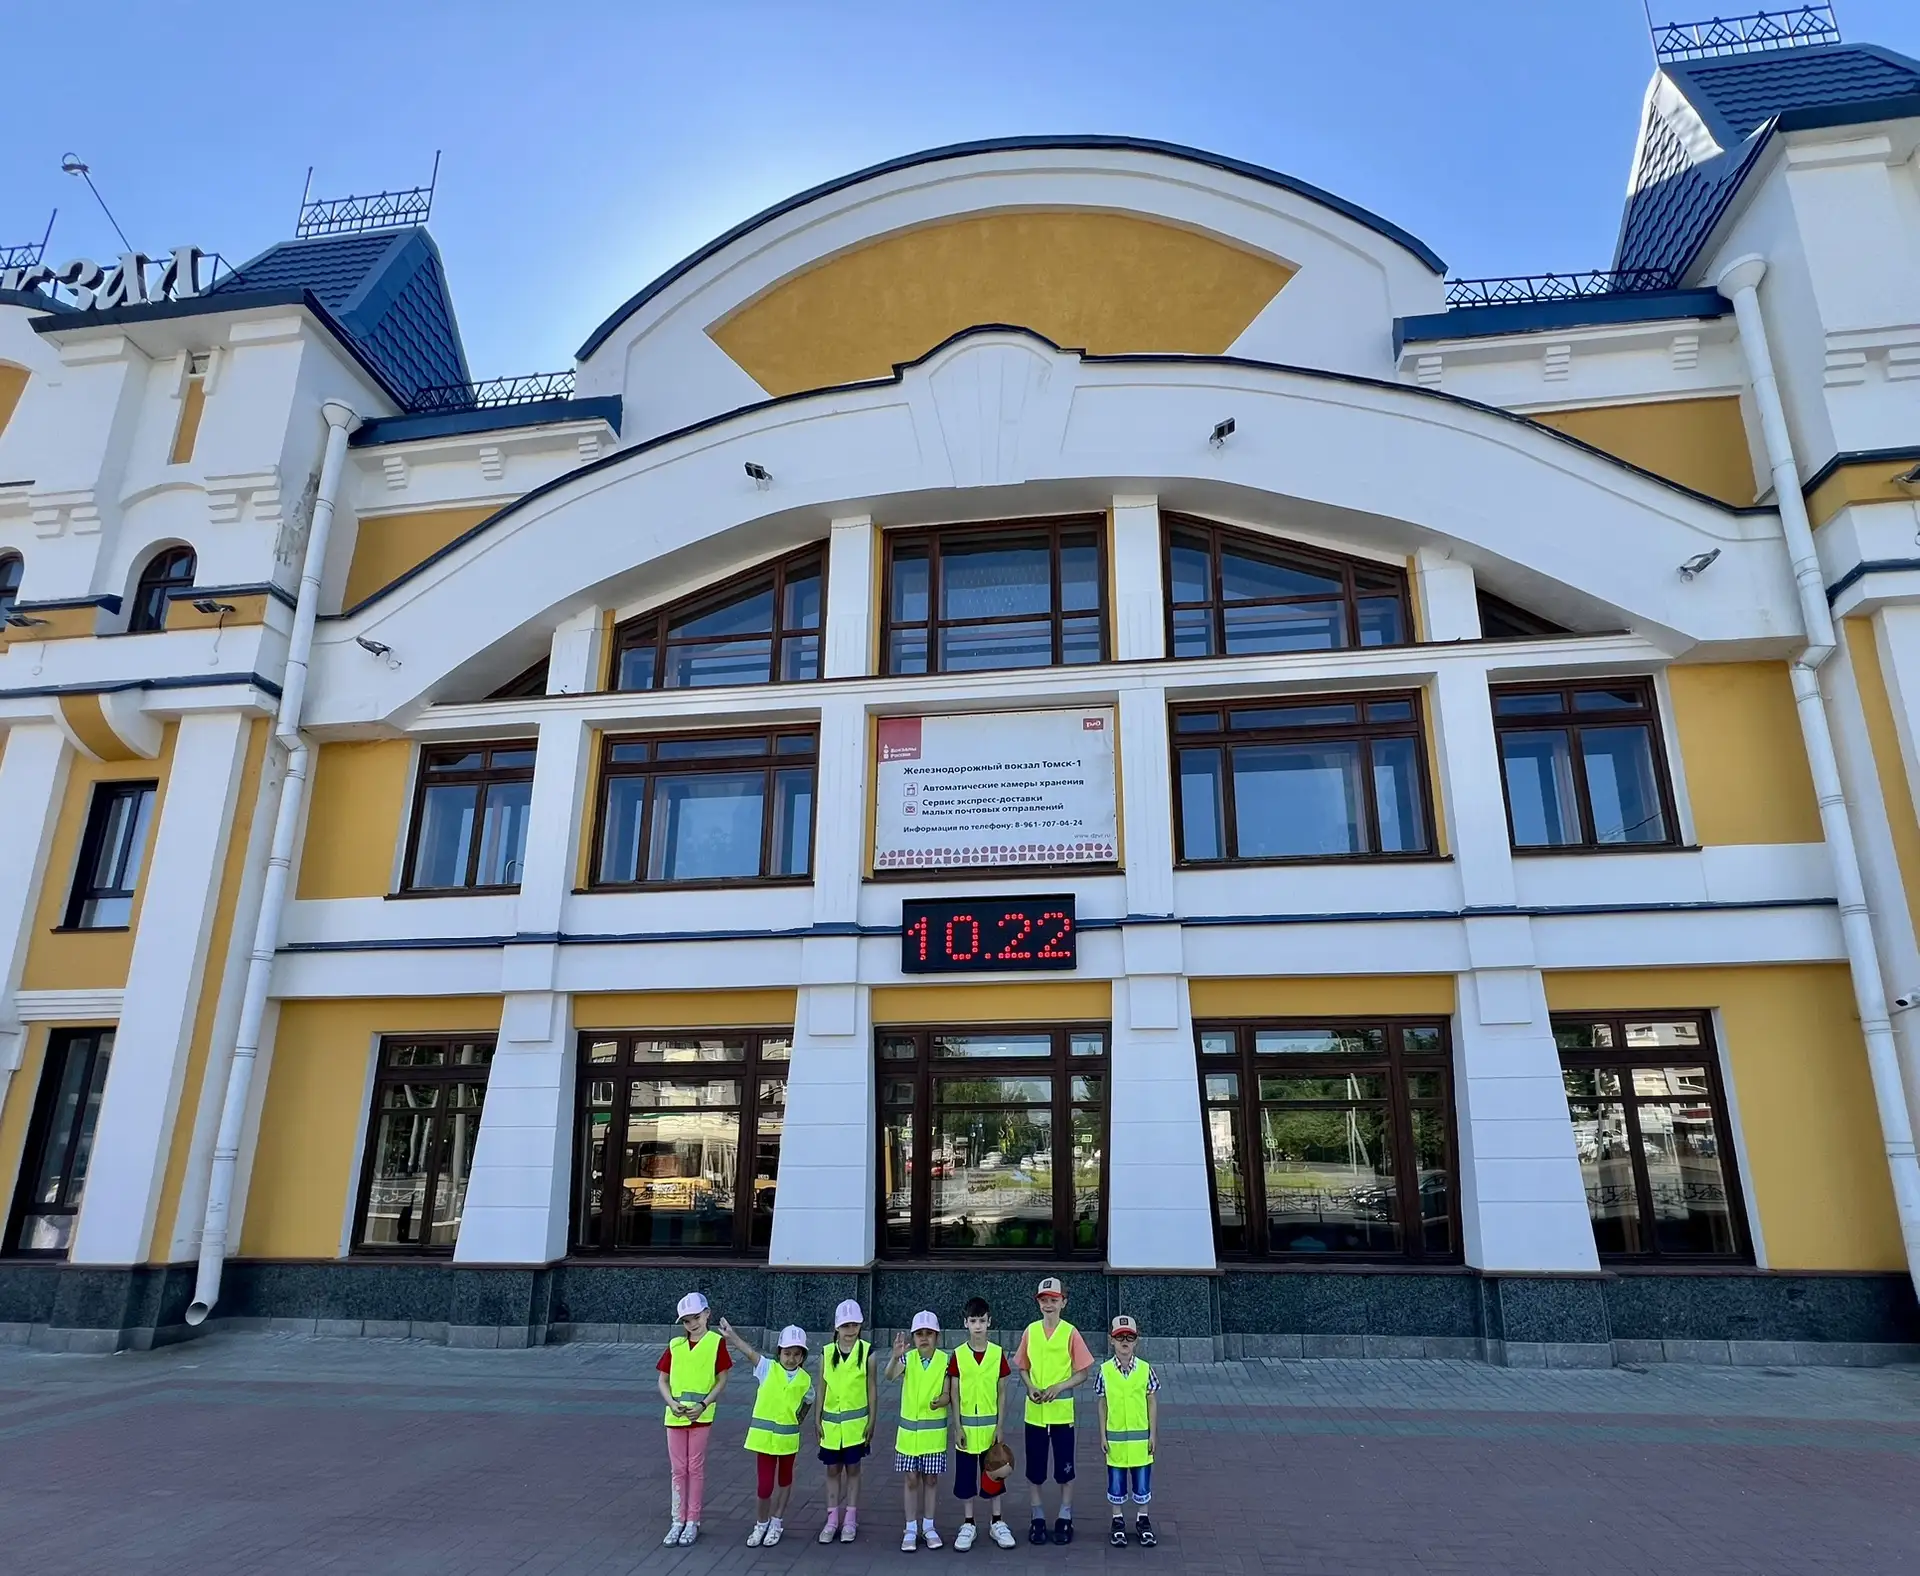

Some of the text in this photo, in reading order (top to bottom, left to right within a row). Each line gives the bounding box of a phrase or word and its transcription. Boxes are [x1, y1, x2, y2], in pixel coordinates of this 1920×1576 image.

[904, 760, 1081, 775] Железнодорожный вокзал Томск-1
[923, 783, 999, 791] Автоматические
[1039, 779, 1084, 787] хранения
[922, 796, 1043, 807] Сервис экспресс-доставки
[1002, 803, 1064, 813] отправлений
[903, 825, 958, 833] Информация
[971, 822, 1013, 830] телефону:
[1015, 820, 1083, 828] 8-961-707-04-24
[907, 911, 1071, 961] 10.22
